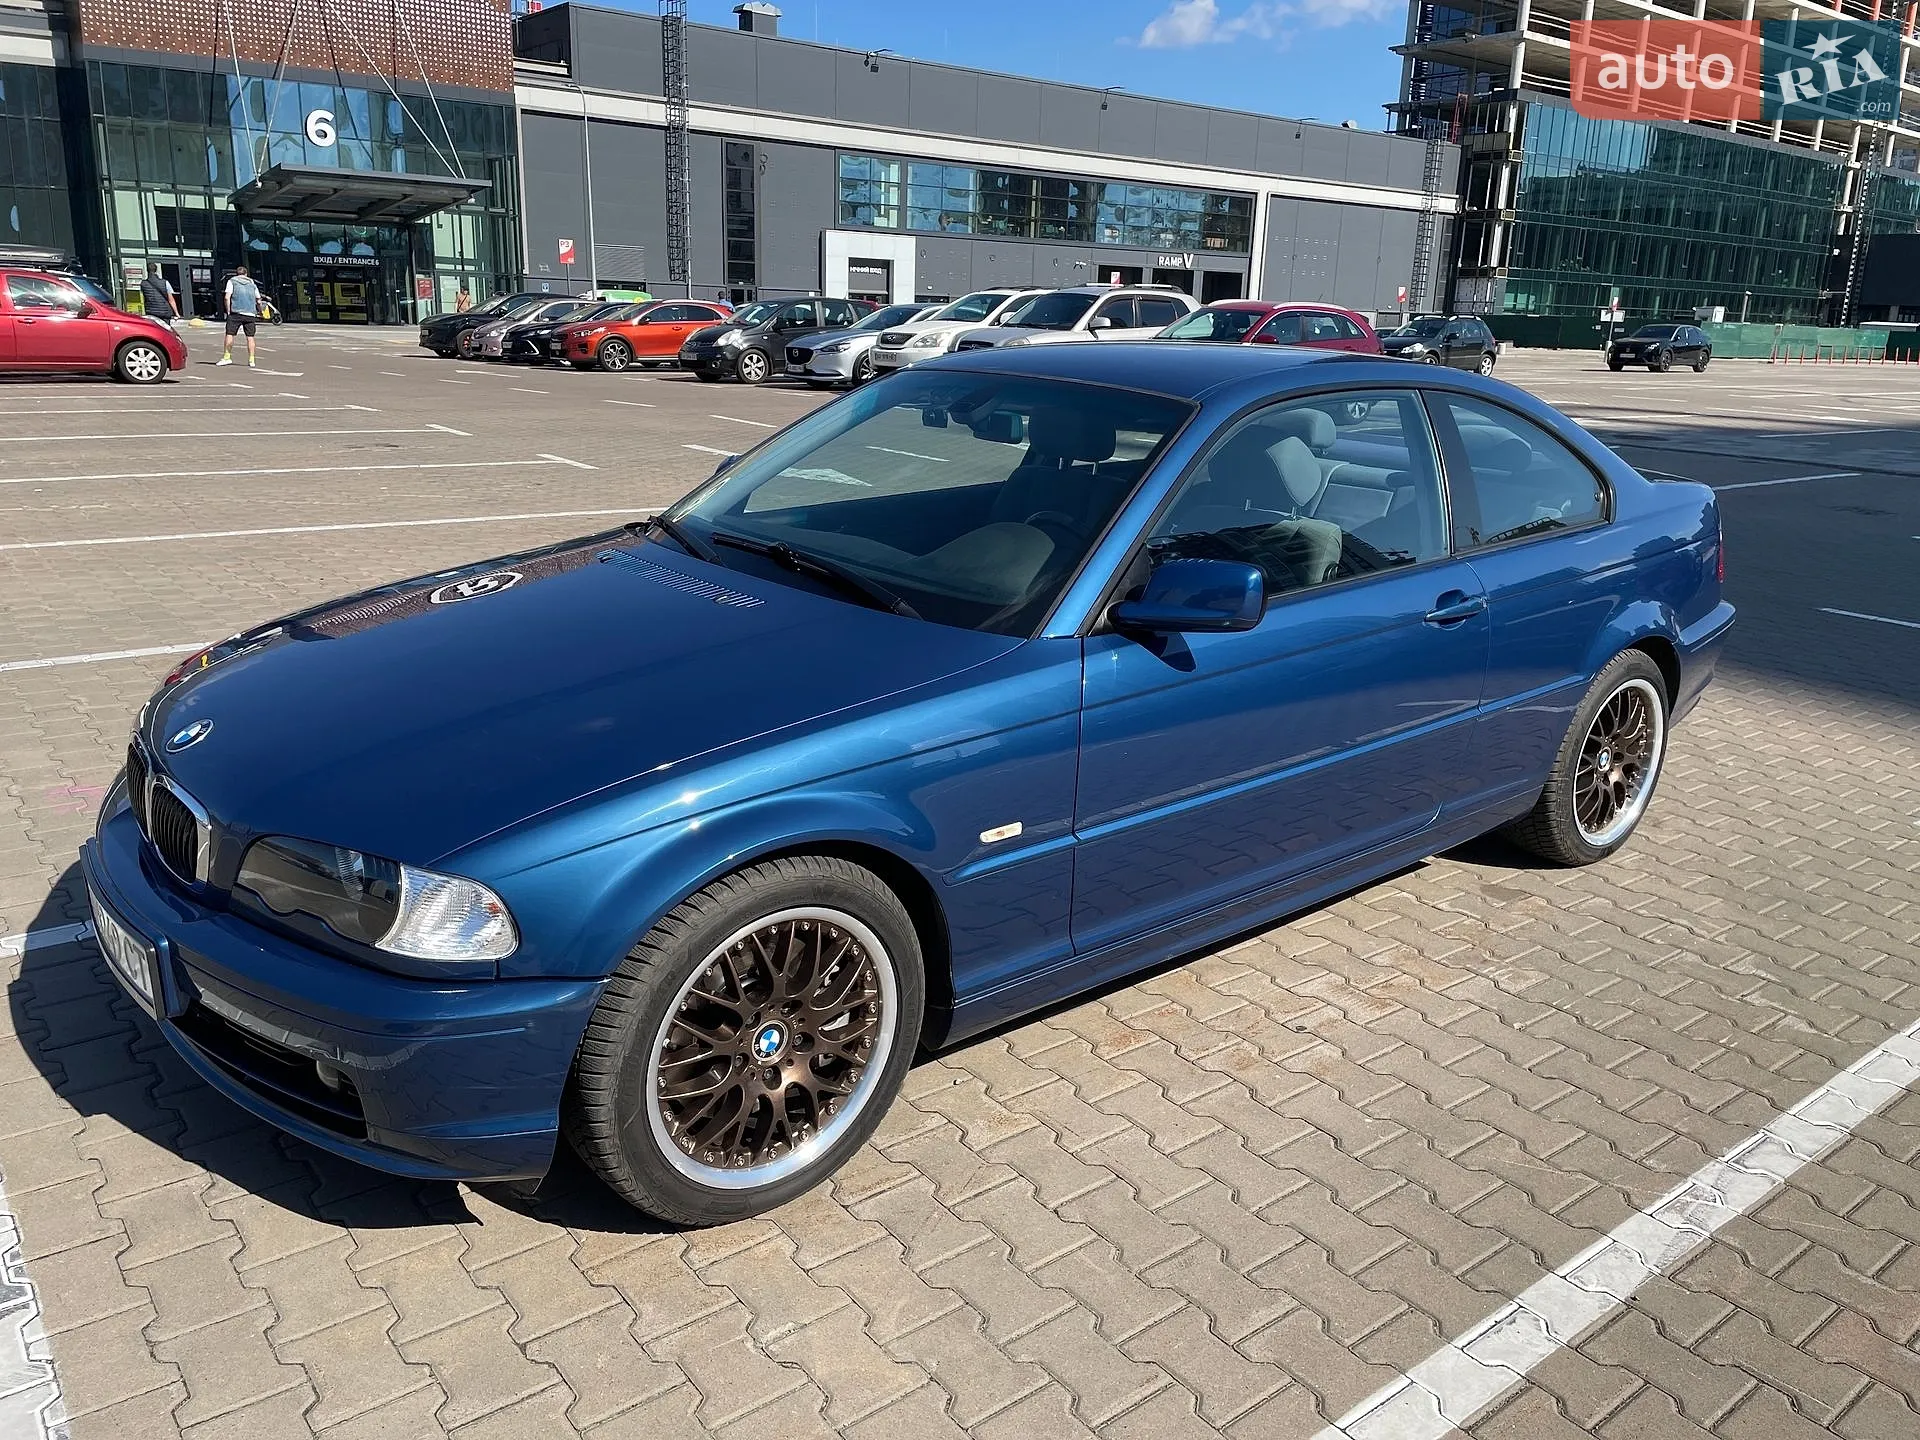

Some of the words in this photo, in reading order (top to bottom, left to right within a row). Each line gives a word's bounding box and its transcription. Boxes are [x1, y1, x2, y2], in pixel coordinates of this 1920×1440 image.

[306, 109, 336, 147] 6
[338, 257, 375, 266] ENTRANCE
[1158, 256, 1183, 267] RAMP
[1184, 252, 1194, 269] V
